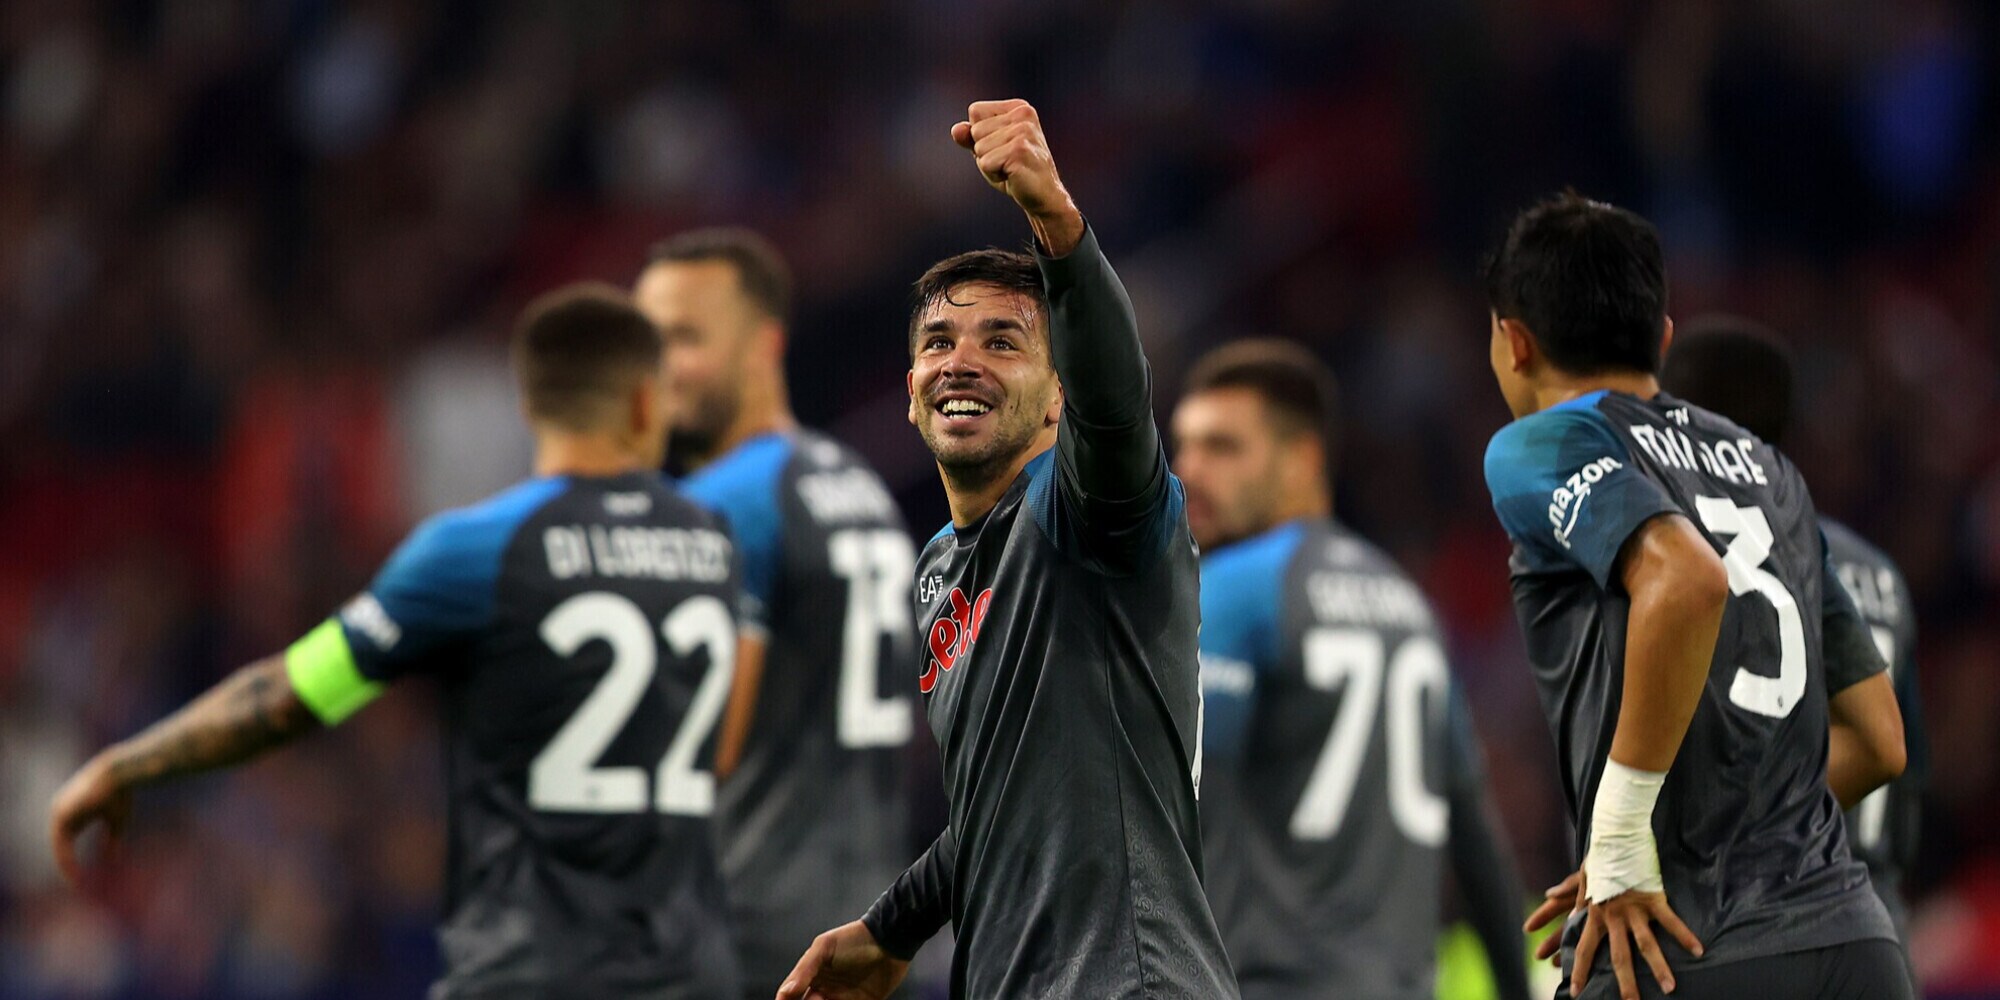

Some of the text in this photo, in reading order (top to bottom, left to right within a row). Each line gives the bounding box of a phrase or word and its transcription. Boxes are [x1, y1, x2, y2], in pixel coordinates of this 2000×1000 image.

[528, 591, 738, 814] 22
[1695, 494, 1808, 719] 3
[1288, 626, 1451, 848] 70
